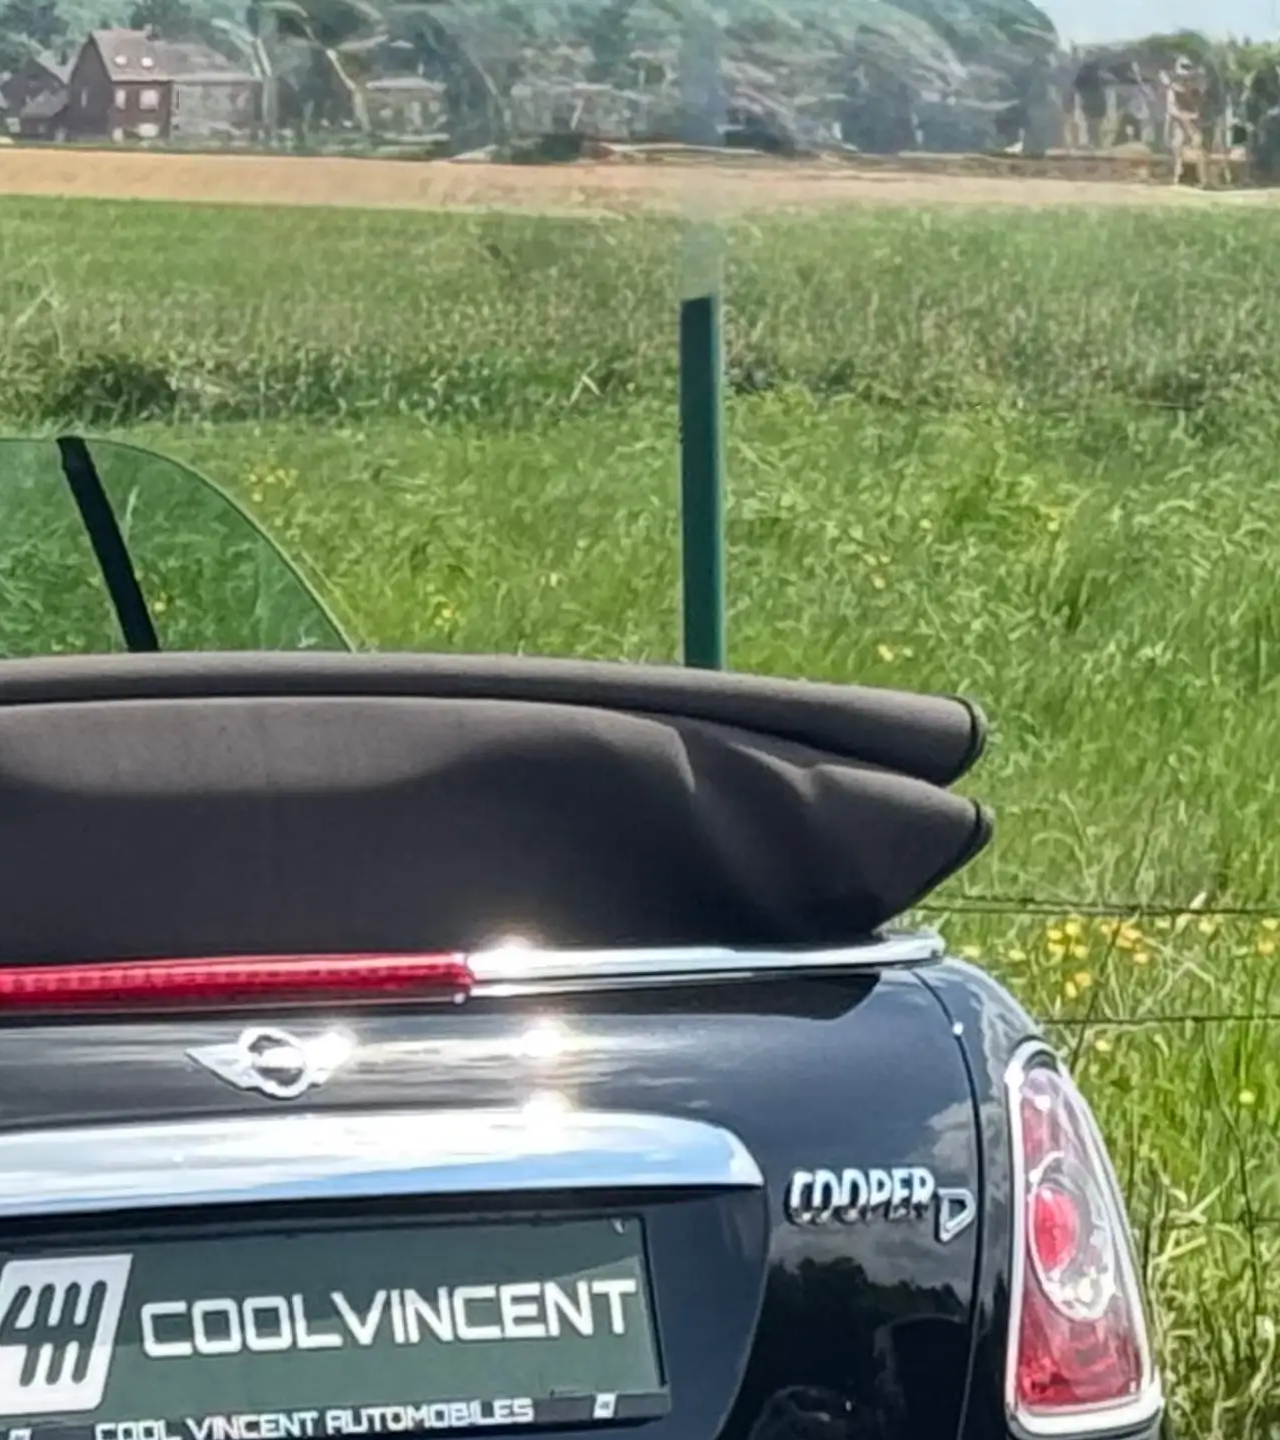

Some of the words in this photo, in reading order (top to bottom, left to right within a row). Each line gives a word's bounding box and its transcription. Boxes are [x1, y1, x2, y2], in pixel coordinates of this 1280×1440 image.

[790, 1166, 936, 1223] COOPER
[936, 1187, 977, 1242] D
[141, 1279, 637, 1357] COOLVINCENT
[326, 1397, 534, 1436] AUTOMOBILES
